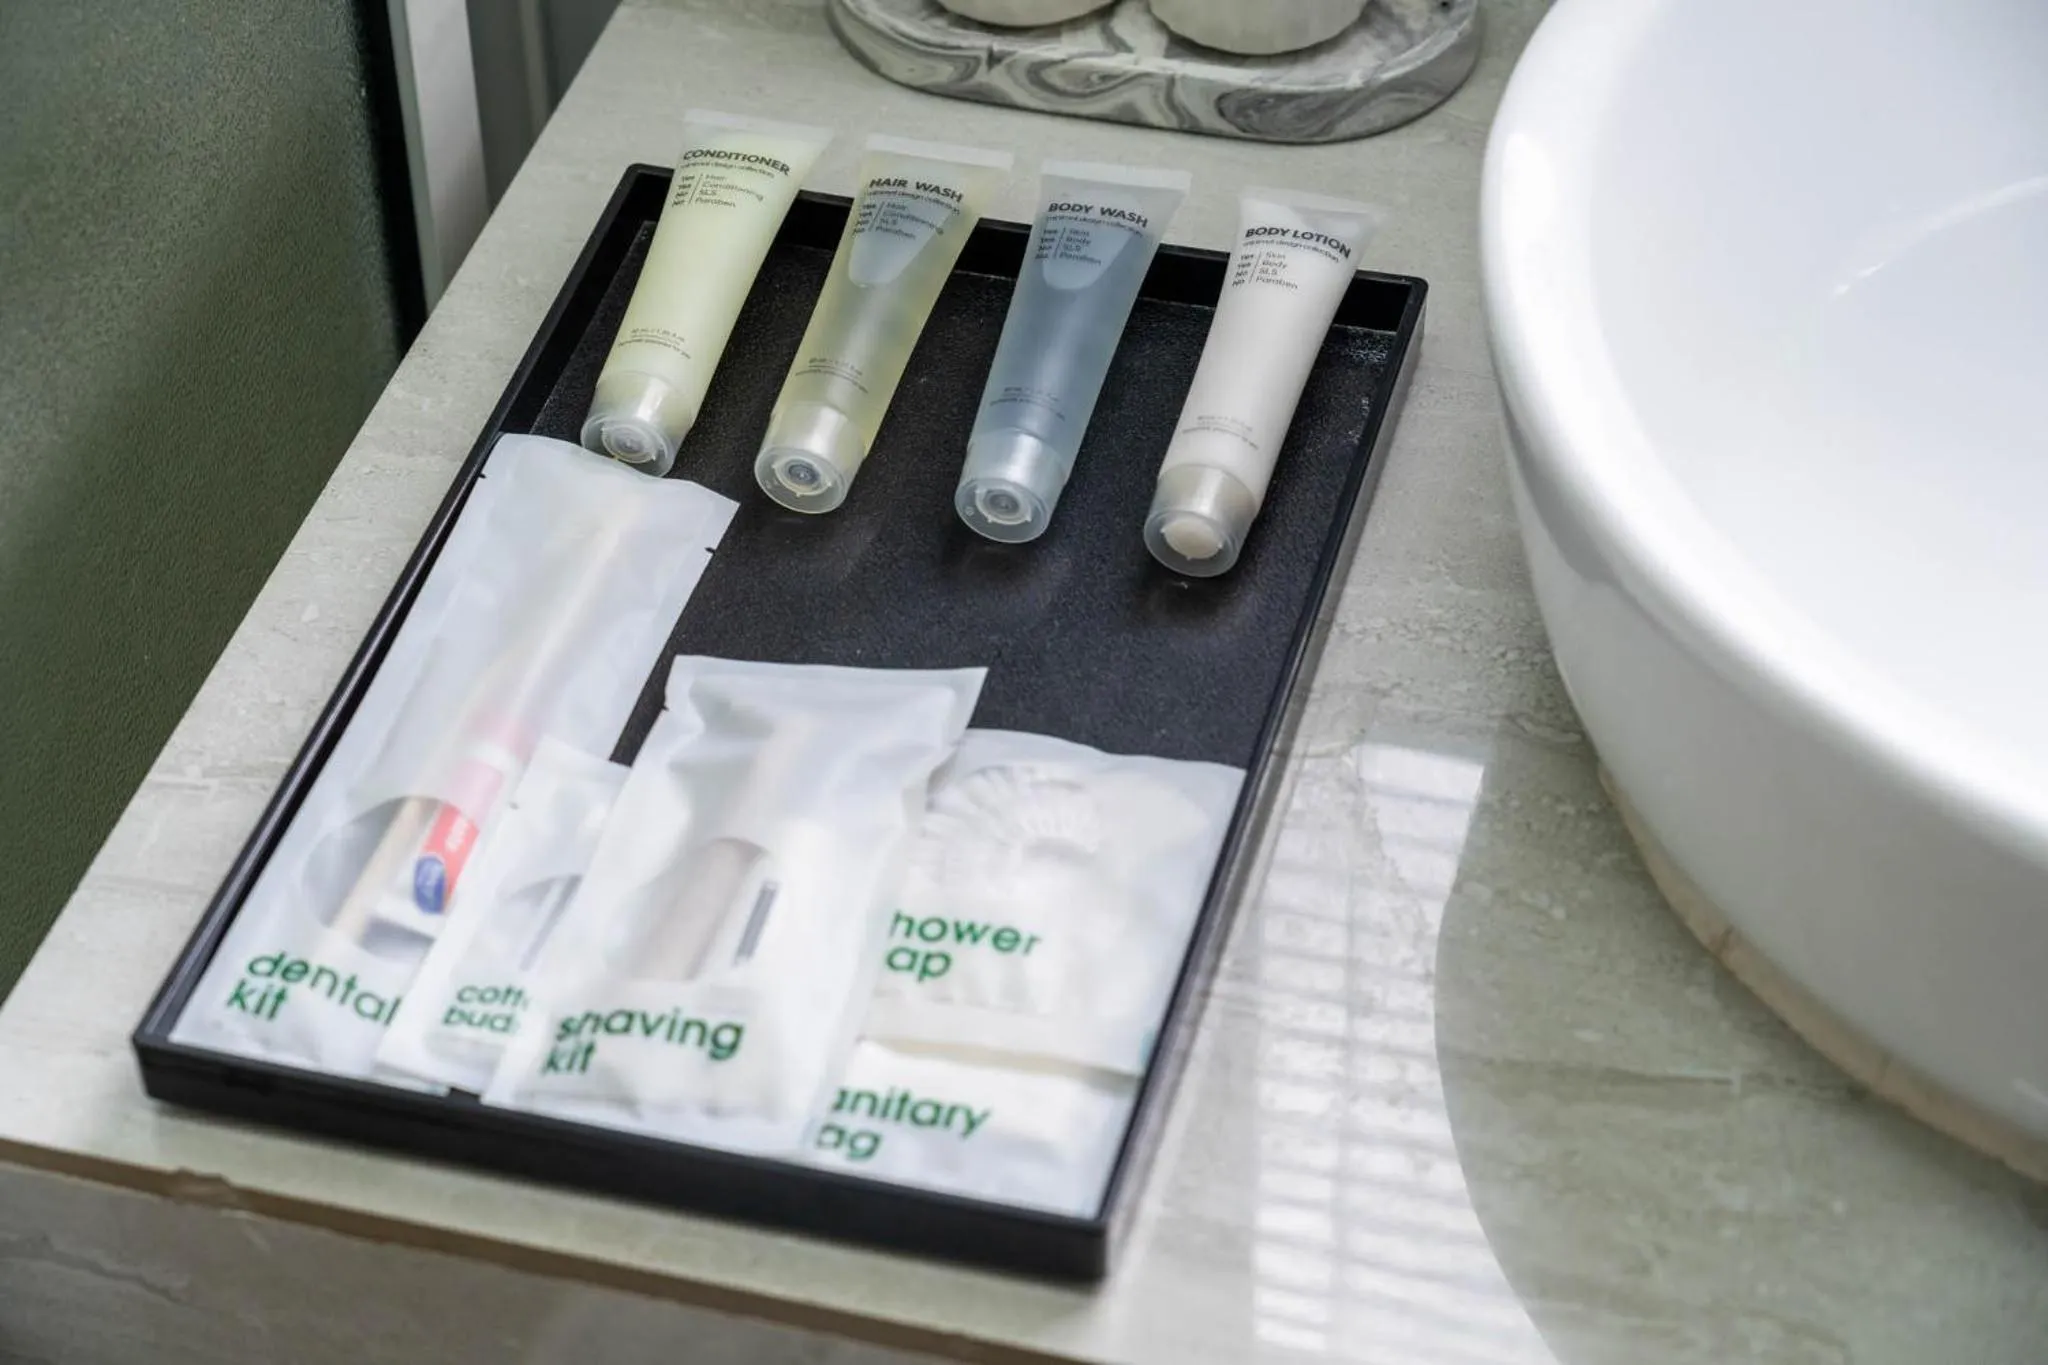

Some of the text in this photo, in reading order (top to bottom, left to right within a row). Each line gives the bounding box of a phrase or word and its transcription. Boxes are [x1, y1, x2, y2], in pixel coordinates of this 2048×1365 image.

[683, 149, 791, 176] CONDITIONER
[869, 178, 964, 202] HAIR WASH
[1048, 203, 1094, 213] BODY
[1100, 207, 1149, 228] WASH
[1245, 227, 1290, 238] BODY
[1292, 229, 1352, 259] LOTION
[889, 909, 1042, 956] hower
[885, 947, 953, 984] ap
[227, 979, 287, 1021] kit
[248, 951, 402, 1027] dental
[457, 985, 529, 1010] cott
[444, 1006, 519, 1033] bud
[541, 1042, 596, 1076] kit
[832, 1085, 992, 1140] nitary
[815, 1122, 882, 1161] ag
